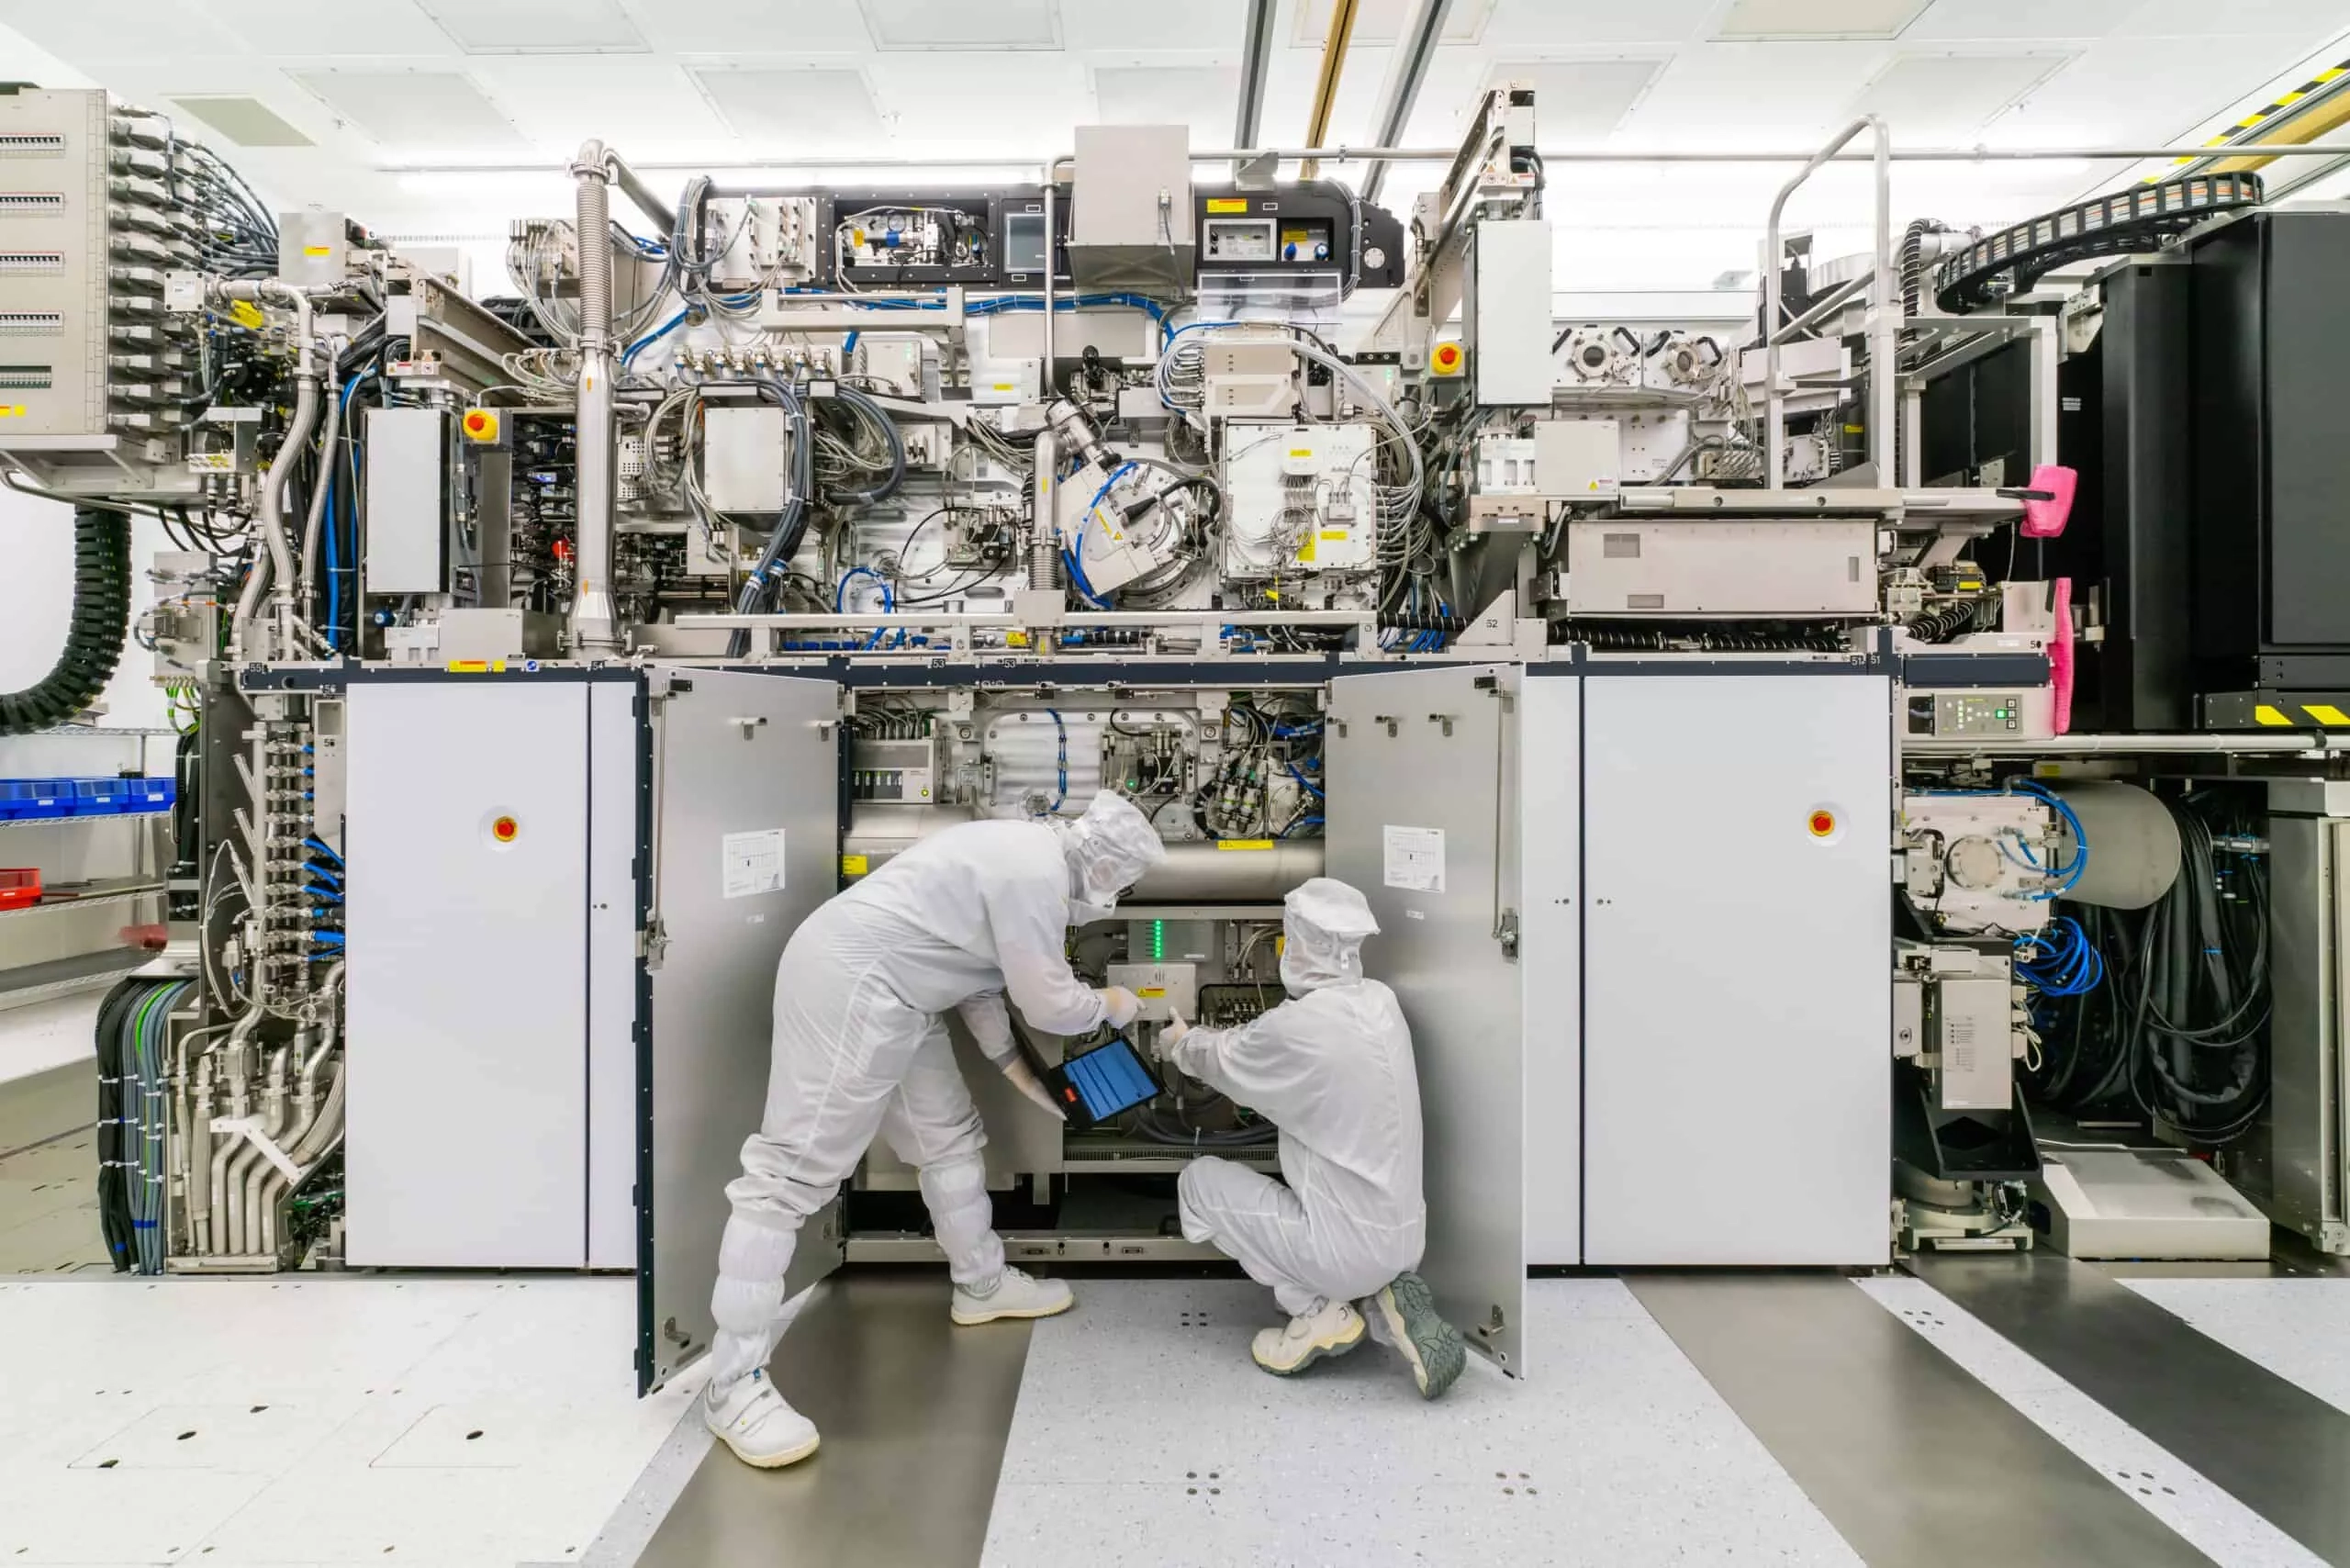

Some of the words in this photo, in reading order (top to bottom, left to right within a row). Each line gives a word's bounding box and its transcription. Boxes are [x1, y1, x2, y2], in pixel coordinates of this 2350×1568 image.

[1486, 619, 1498, 628] 52
[933, 659, 946, 668] 53
[1004, 659, 1015, 668] 53
